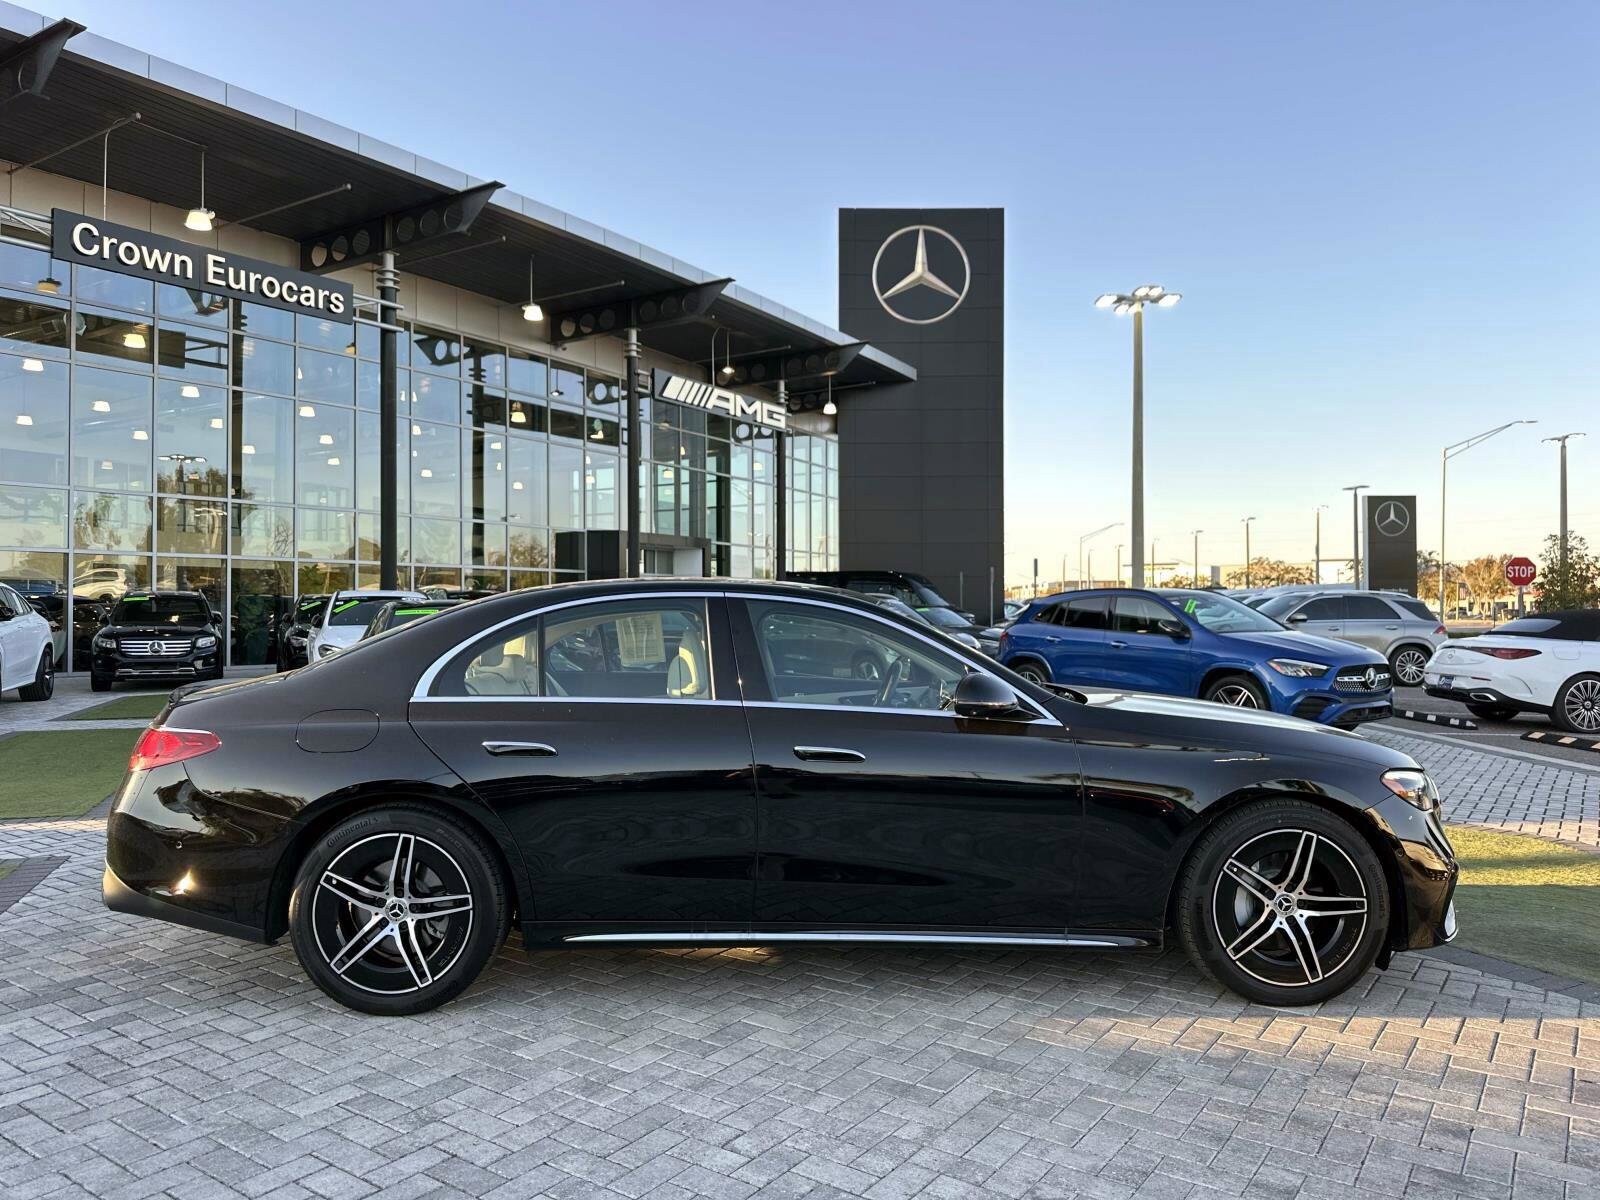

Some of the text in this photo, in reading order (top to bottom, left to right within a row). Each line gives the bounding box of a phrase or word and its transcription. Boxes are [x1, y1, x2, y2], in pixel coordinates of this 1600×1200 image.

[72, 222, 345, 314] Crown Eurocars
[706, 386, 786, 429] AMG
[1507, 566, 1535, 578] STOP
